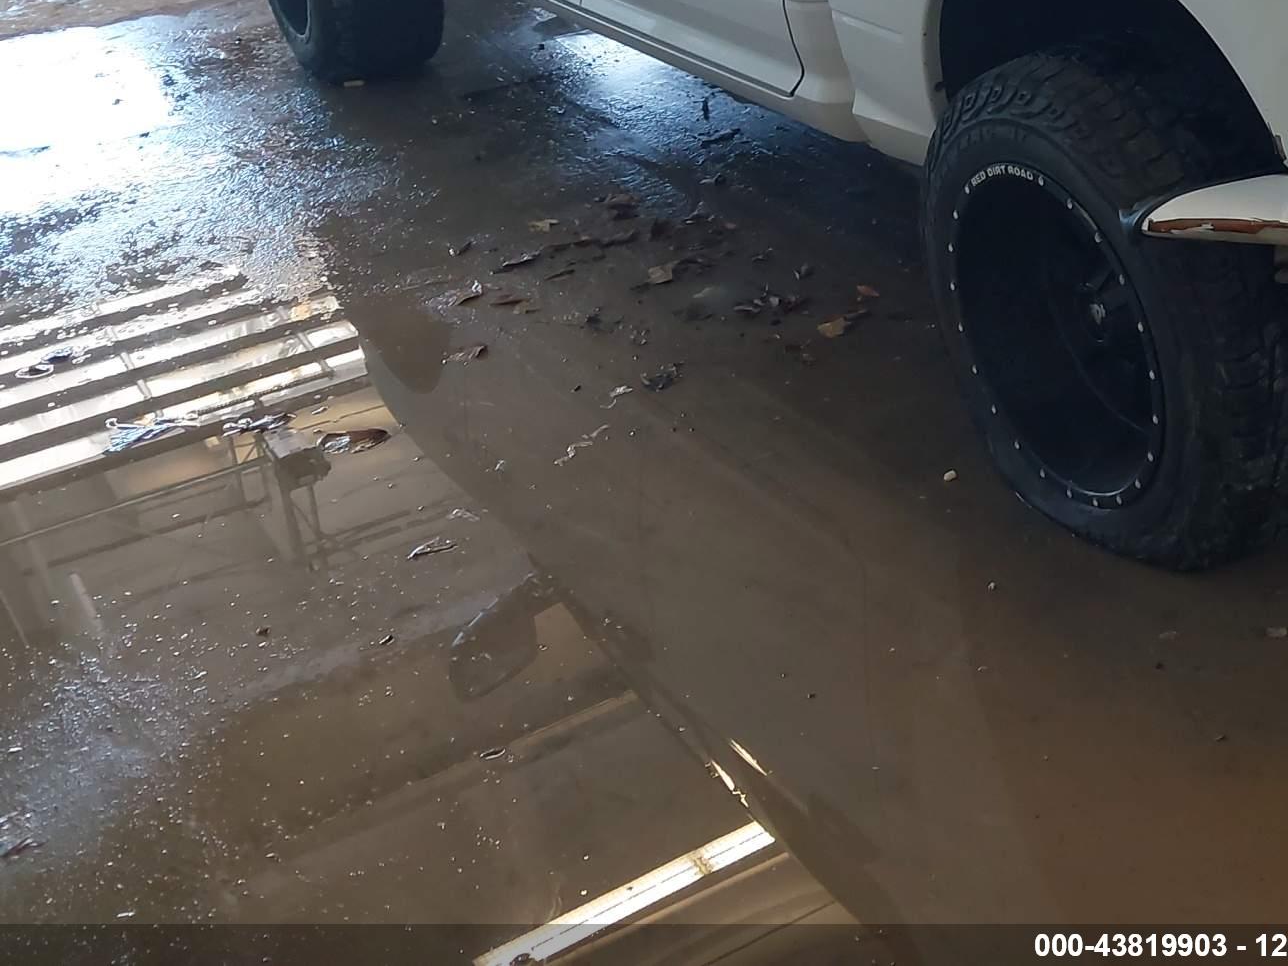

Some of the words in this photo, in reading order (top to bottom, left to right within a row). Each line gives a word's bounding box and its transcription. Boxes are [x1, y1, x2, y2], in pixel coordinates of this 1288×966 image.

[971, 172, 986, 186] RED
[987, 165, 1006, 177] DIRT
[1007, 165, 1033, 180] ROAD
